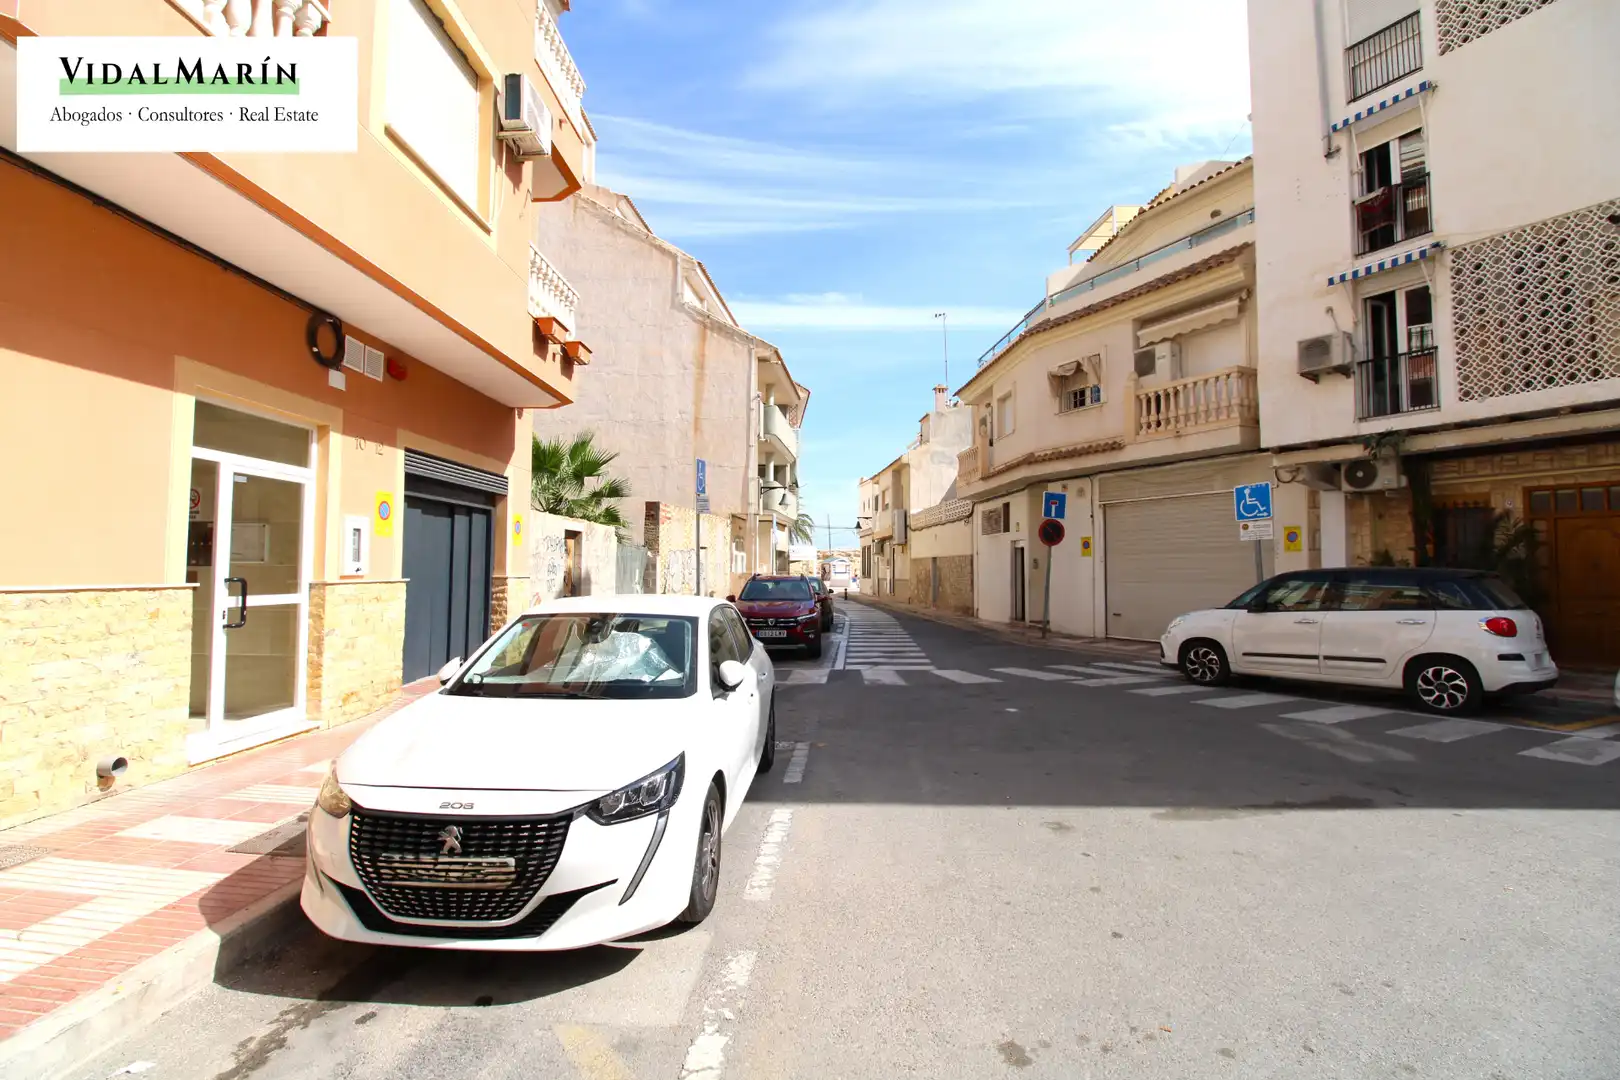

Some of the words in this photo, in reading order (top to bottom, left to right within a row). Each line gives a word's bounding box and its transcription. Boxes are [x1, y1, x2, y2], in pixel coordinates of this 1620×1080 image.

[354, 436, 367, 451] 10
[374, 441, 385, 456] 12
[438, 801, 475, 810] 208
